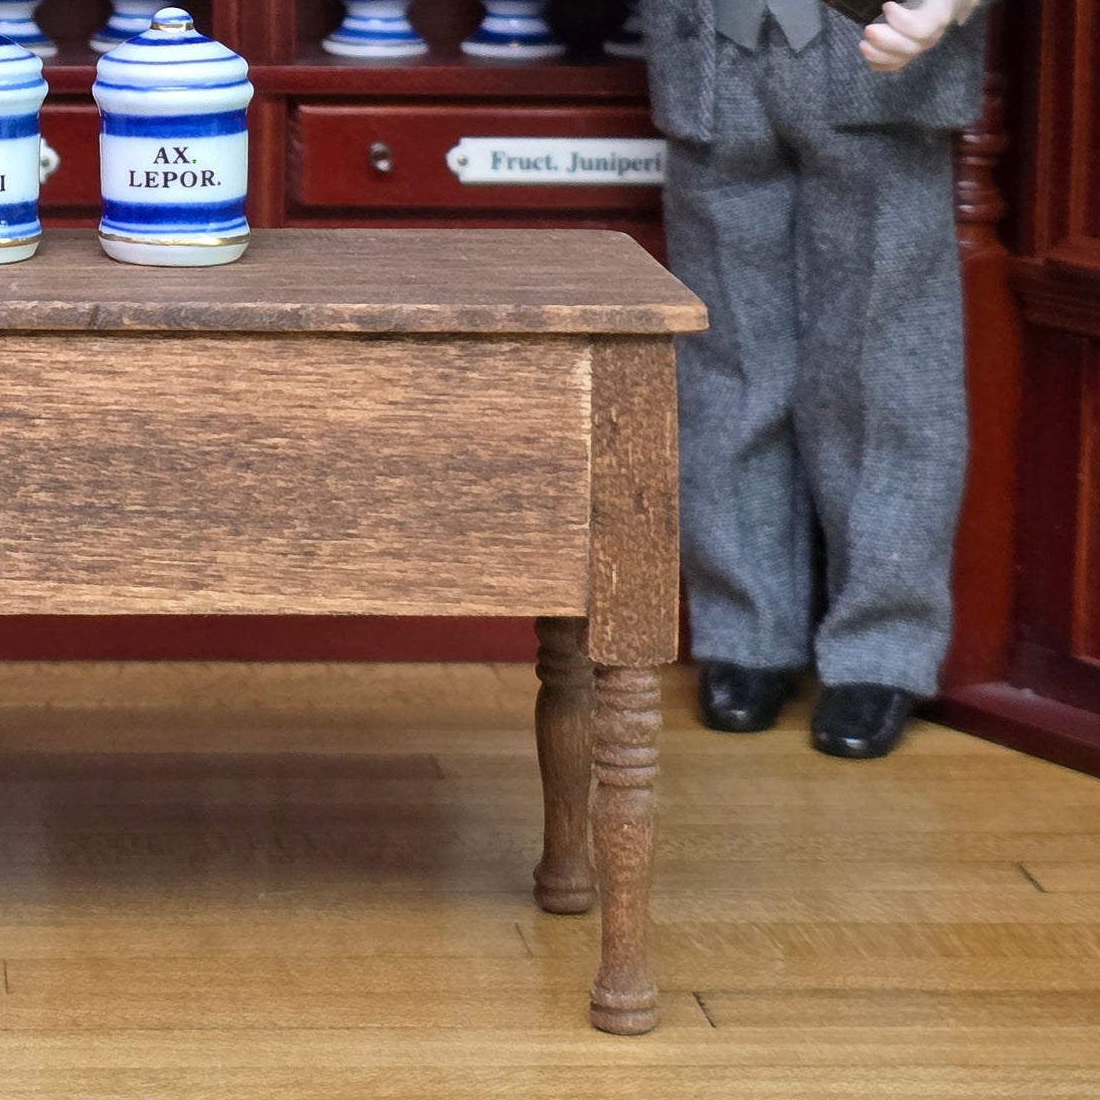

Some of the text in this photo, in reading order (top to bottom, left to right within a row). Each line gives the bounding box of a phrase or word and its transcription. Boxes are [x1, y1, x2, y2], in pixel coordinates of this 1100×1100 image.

[154, 146, 197, 165] AX.
[491, 151, 662, 176] Fruct. Juniperi
[129, 169, 222, 189] LEPOR.
